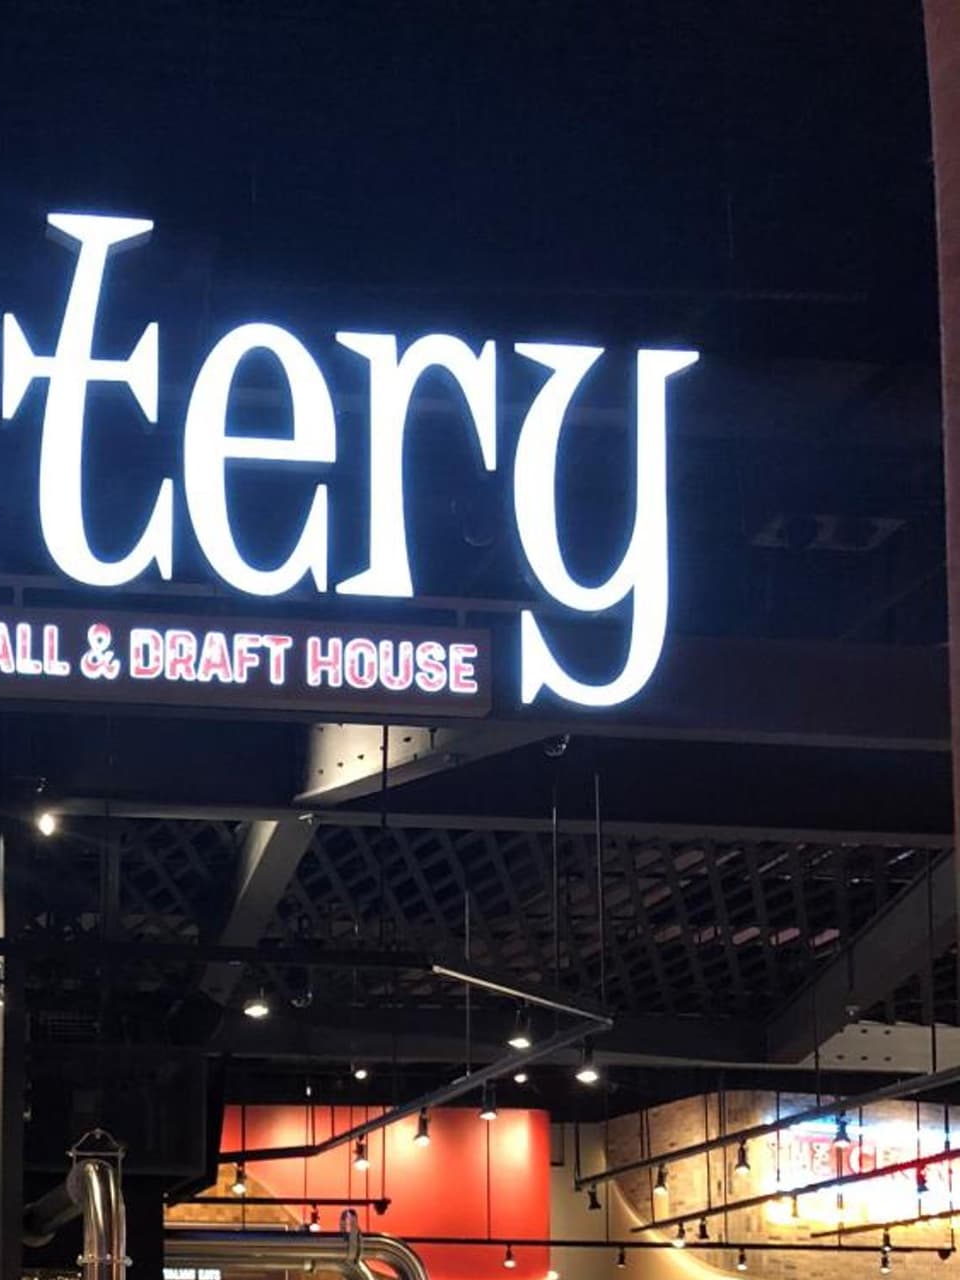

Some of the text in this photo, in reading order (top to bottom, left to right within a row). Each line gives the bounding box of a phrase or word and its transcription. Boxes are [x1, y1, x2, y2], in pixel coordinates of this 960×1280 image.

[80, 622, 120, 680] &
[130, 628, 293, 686] DRAFT
[306, 636, 478, 694] HOUSE
